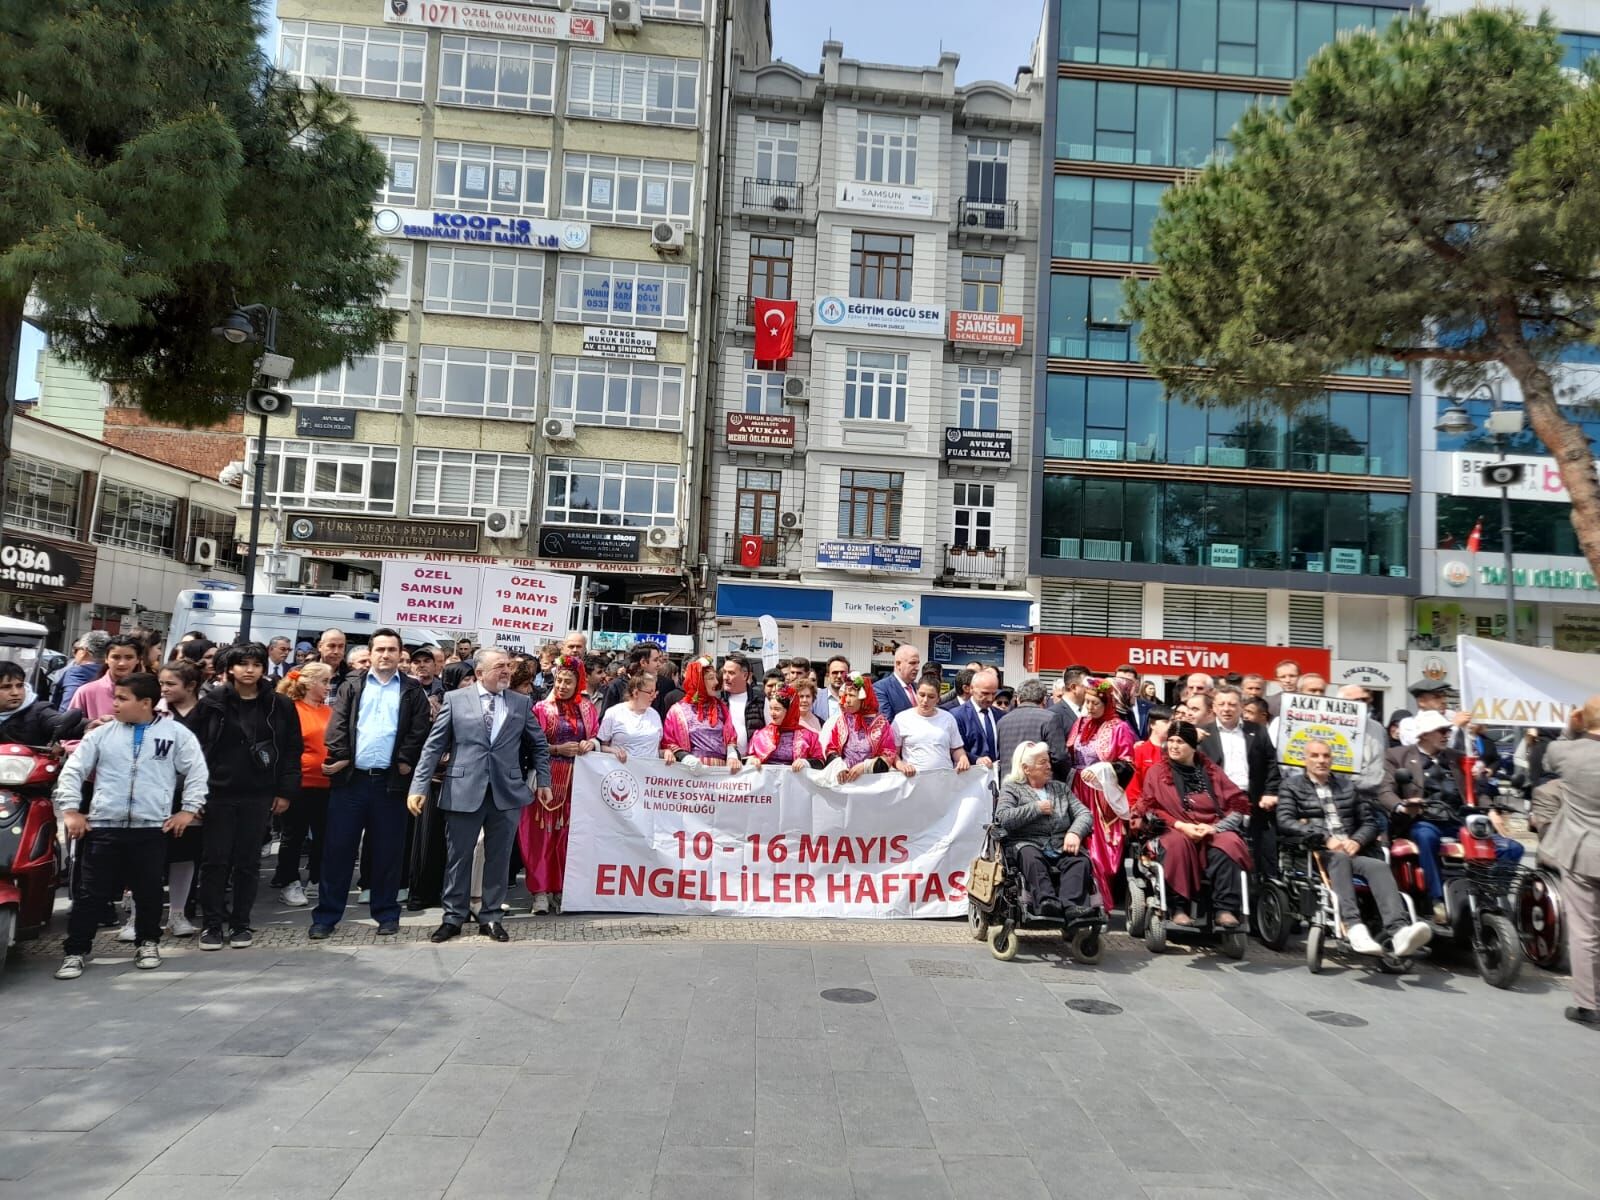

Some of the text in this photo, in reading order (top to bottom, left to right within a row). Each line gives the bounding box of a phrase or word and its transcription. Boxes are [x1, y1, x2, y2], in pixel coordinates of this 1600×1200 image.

[420, 3, 457, 25] 1071
[861, 189, 901, 199] SAMSUN
[848, 303, 939, 320] EĞİTİM GÜCÜ SEN
[957, 312, 1000, 321] SEVDAMIZ
[608, 330, 636, 338] DENGE
[955, 320, 1016, 335] SAMSUN
[589, 335, 617, 344] HUKUK
[739, 426, 789, 435] AVUKAT
[969, 440, 1006, 449] AVUKAT
[947, 449, 1010, 459] FUAT SARIKAYA
[317, 519, 352, 532] TÜRK
[357, 522, 399, 534] METAL
[1, 546, 50, 572] OBA
[311, 549, 345, 557] KEBAP
[549, 560, 582, 569] KEBAP
[596, 563, 643, 573] KAHVALTI
[656, 566, 676, 574] 7/24
[0, 567, 65, 587] staurant
[414, 567, 452, 580] ÖZEL
[16, 581, 33, 590] 1971
[400, 582, 463, 596] SAMSUN
[511, 575, 546, 589] ÖZEL
[407, 598, 455, 610] BAKIM
[496, 589, 558, 605] 19 MAYIS
[502, 604, 548, 617] BAKIM
[845, 602, 899, 612] Türk Telekom
[396, 612, 463, 625] MERKEZİ
[491, 617, 554, 633] MERKEZİ
[496, 633, 521, 642] BAKIM
[818, 640, 843, 648] tivibu
[1290, 696, 1320, 711] AKAY
[1471, 697, 1542, 722] AKAY
[154, 738, 174, 757] W
[644, 776, 684, 788] TÜRKİYE
[643, 788, 772, 804] AİLE VE SOSYAL HİZMETLER
[673, 830, 712, 861] 10
[747, 833, 788, 864] 16
[799, 834, 909, 865] MAYIS
[596, 864, 968, 904] ENGELLİLER HAFTAS
